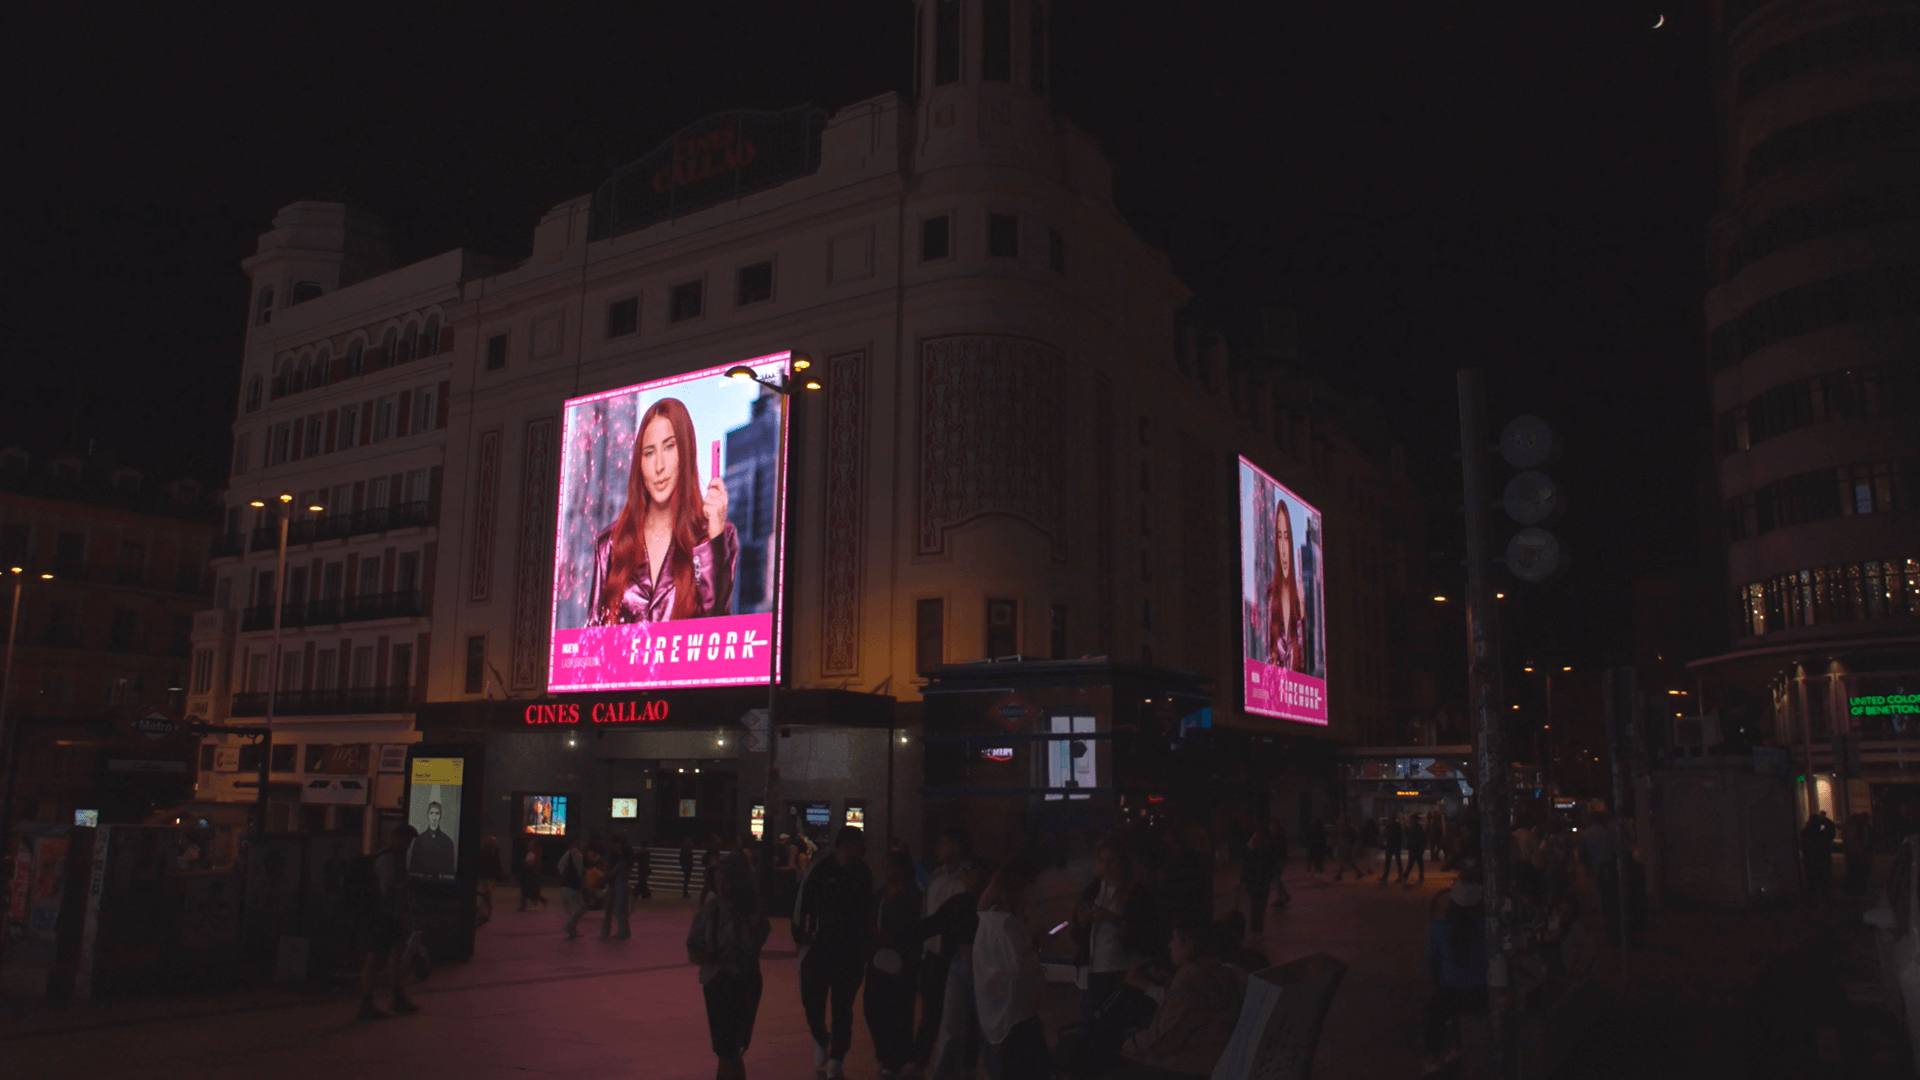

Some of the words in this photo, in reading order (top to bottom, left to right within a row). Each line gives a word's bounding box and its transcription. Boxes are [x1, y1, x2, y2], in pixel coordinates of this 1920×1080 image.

[653, 141, 756, 193] CALLAO
[629, 630, 768, 665] FIREWORK
[1279, 679, 1322, 710] FIREWORK
[1849, 695, 1886, 706] UNITED
[525, 704, 580, 724] CINES
[591, 700, 668, 723] CALLAO
[1850, 706, 1864, 716] OF
[139, 720, 172, 732] Metro
